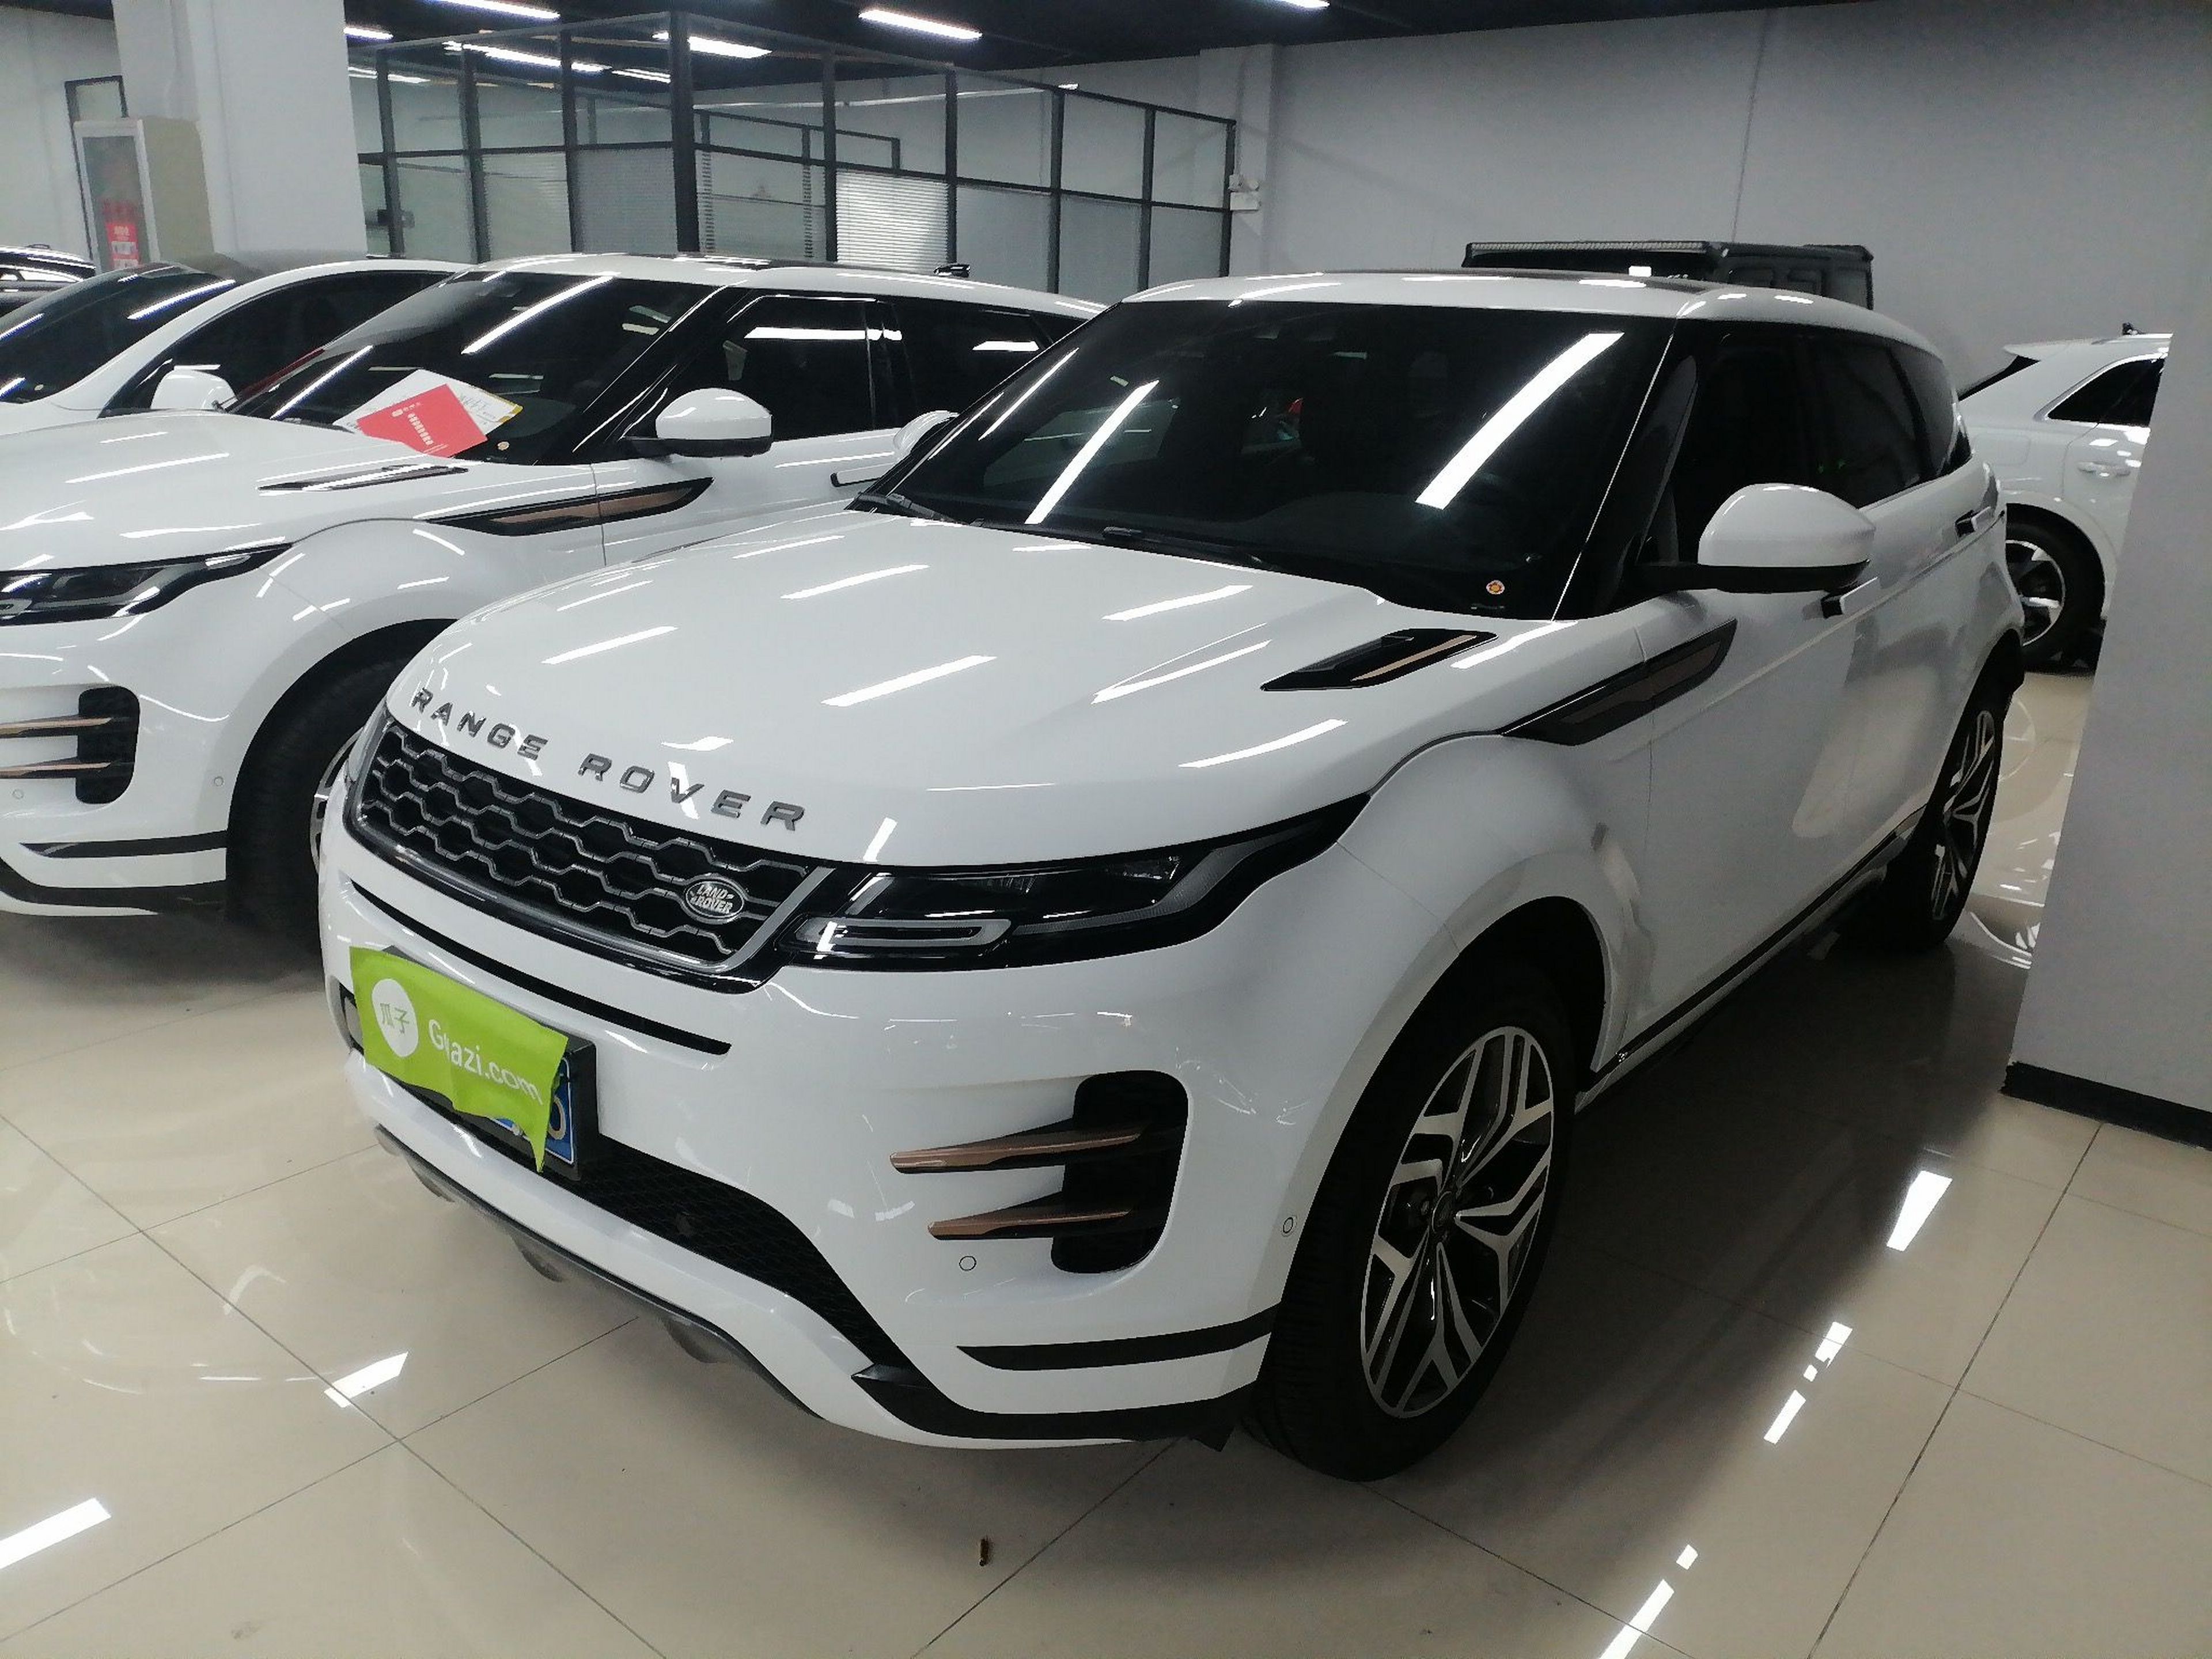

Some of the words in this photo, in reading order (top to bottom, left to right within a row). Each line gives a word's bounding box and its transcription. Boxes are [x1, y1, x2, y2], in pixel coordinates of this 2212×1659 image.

[409, 687, 548, 760] RANGE
[577, 753, 805, 831] ROVER
[696, 884, 729, 899] LAND
[694, 896, 733, 914] ROVER
[380, 1002, 410, 1034] 瓜子
